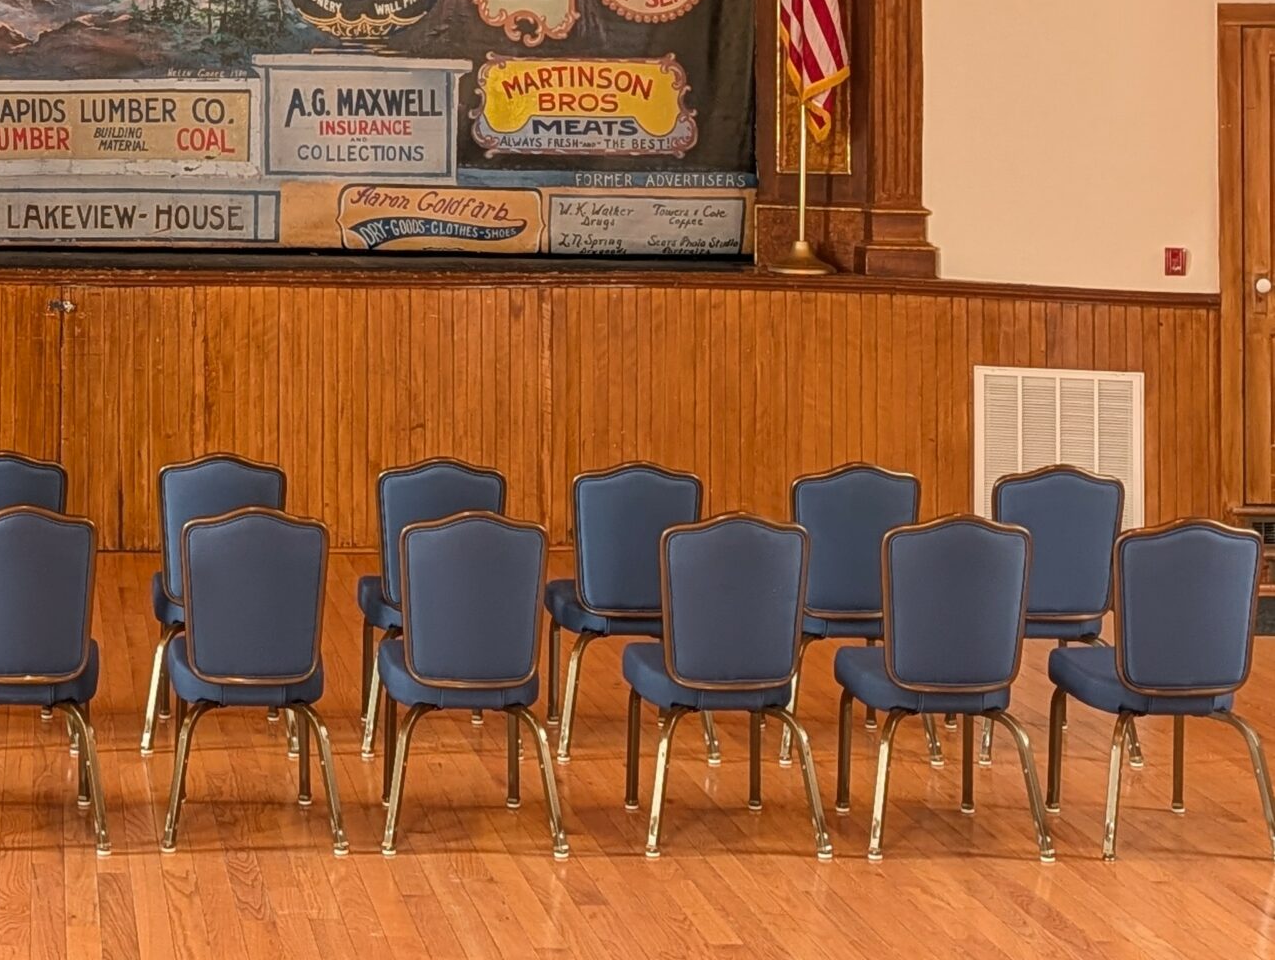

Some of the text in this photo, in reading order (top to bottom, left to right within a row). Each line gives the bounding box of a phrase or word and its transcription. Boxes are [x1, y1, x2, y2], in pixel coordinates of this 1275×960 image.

[374, 2, 401, 16] WALL
[501, 65, 654, 101] MARTINSON
[284, 88, 443, 128] A.G. MAXWELL
[537, 93, 619, 113] BROS
[79, 98, 178, 124] LUMBER
[191, 97, 235, 126] CO.
[93, 127, 143, 140] BUILDING
[319, 120, 413, 136] INSURANCE
[531, 119, 639, 137] MEATS
[97, 139, 150, 152] MATERIAL
[176, 127, 236, 154] COAL
[499, 135, 671, 150] ALWAYS FRESH THE BEST!
[297, 144, 425, 162] COLLECTIONS
[575, 173, 746, 188] FORMER ADVERTISERS
[417, 190, 510, 222] Goldfarb
[591, 202, 635, 217] Walker
[580, 216, 616, 231] Drugs
[668, 216, 704, 229] Coffee
[583, 233, 623, 249] Spring
[708, 236, 739, 248] Studio
